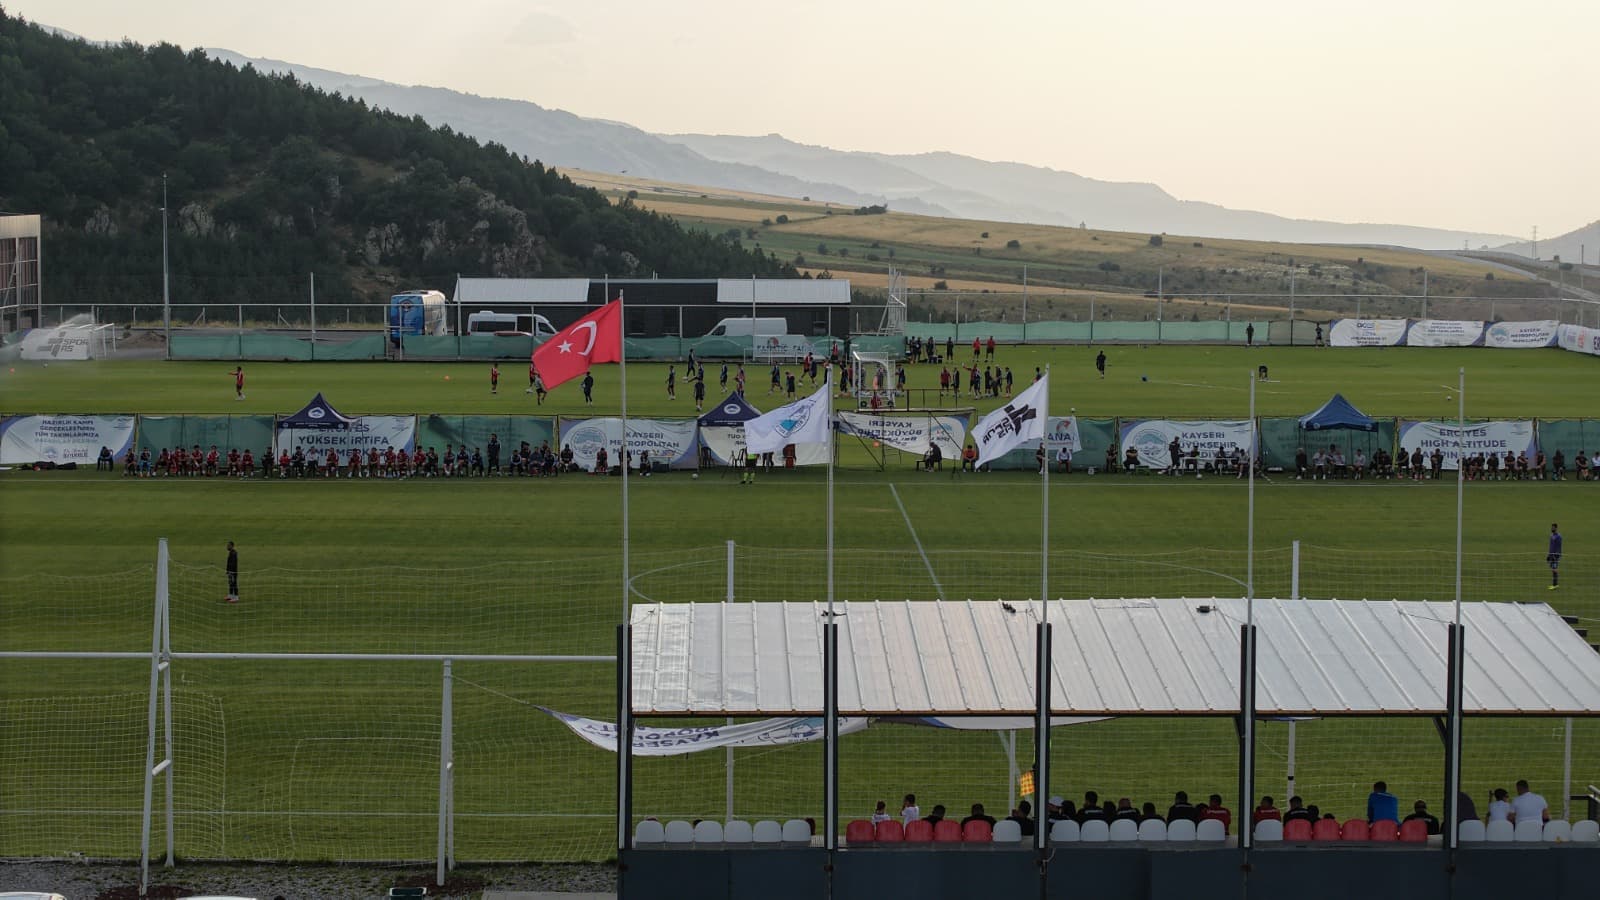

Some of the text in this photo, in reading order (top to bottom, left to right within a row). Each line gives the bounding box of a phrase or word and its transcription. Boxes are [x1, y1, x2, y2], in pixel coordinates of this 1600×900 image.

[298, 435, 346, 445] YÜKSEK
[609, 438, 680, 448] MEROPOLITAN
[1420, 439, 1449, 447] HIGH
[633, 730, 720, 748] KAYSER
